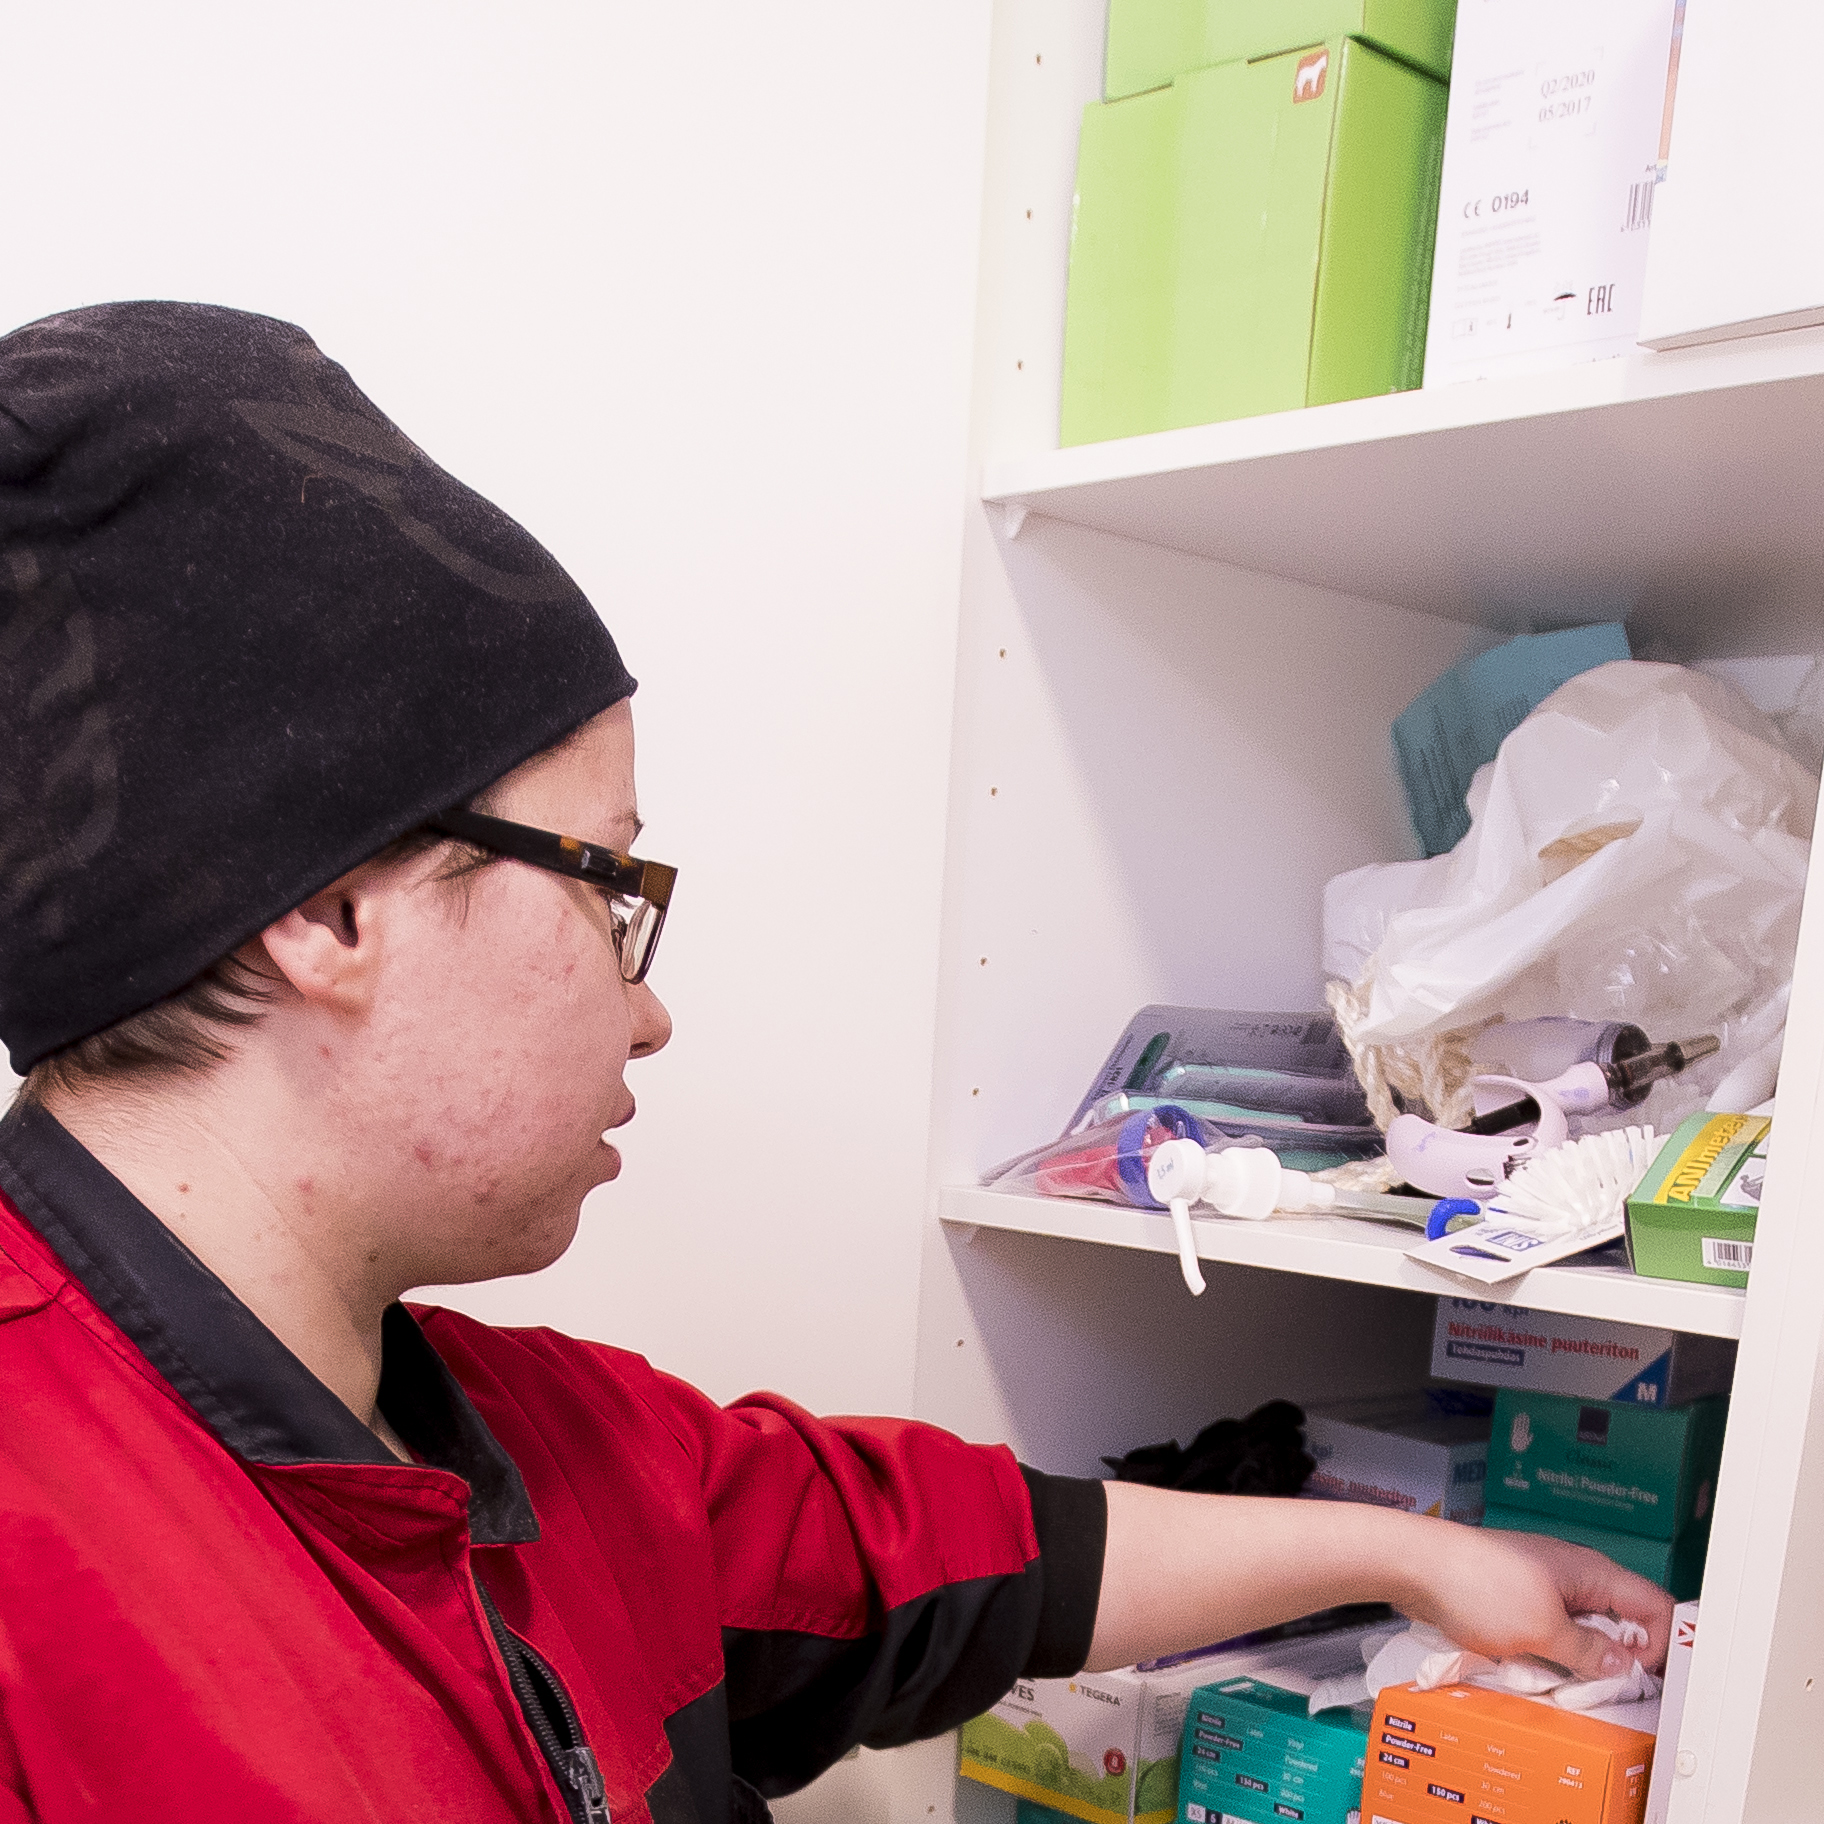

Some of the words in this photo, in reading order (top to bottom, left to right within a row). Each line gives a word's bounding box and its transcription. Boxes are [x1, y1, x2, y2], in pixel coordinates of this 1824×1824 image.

[1541, 70, 1594, 98] Q2/2020
[1539, 96, 1591, 122] 05/2017
[1492, 190, 1529, 213] 0194
[1636, 1382, 1659, 1402] M
[1079, 1684, 1122, 1707] TEGERA
[1388, 1715, 1413, 1731] Nitrile
[1439, 1730, 1459, 1744] Latex
[1486, 1744, 1506, 1758] Vinyl
[1383, 1752, 1393, 1763] 24
[1393, 1756, 1406, 1767] cm
[1385, 1735, 1433, 1757] Powder-Free
[1483, 1762, 1522, 1781] Powdered
[1566, 1765, 1581, 1777] REF
[1446, 1789, 1461, 1803] pcs
